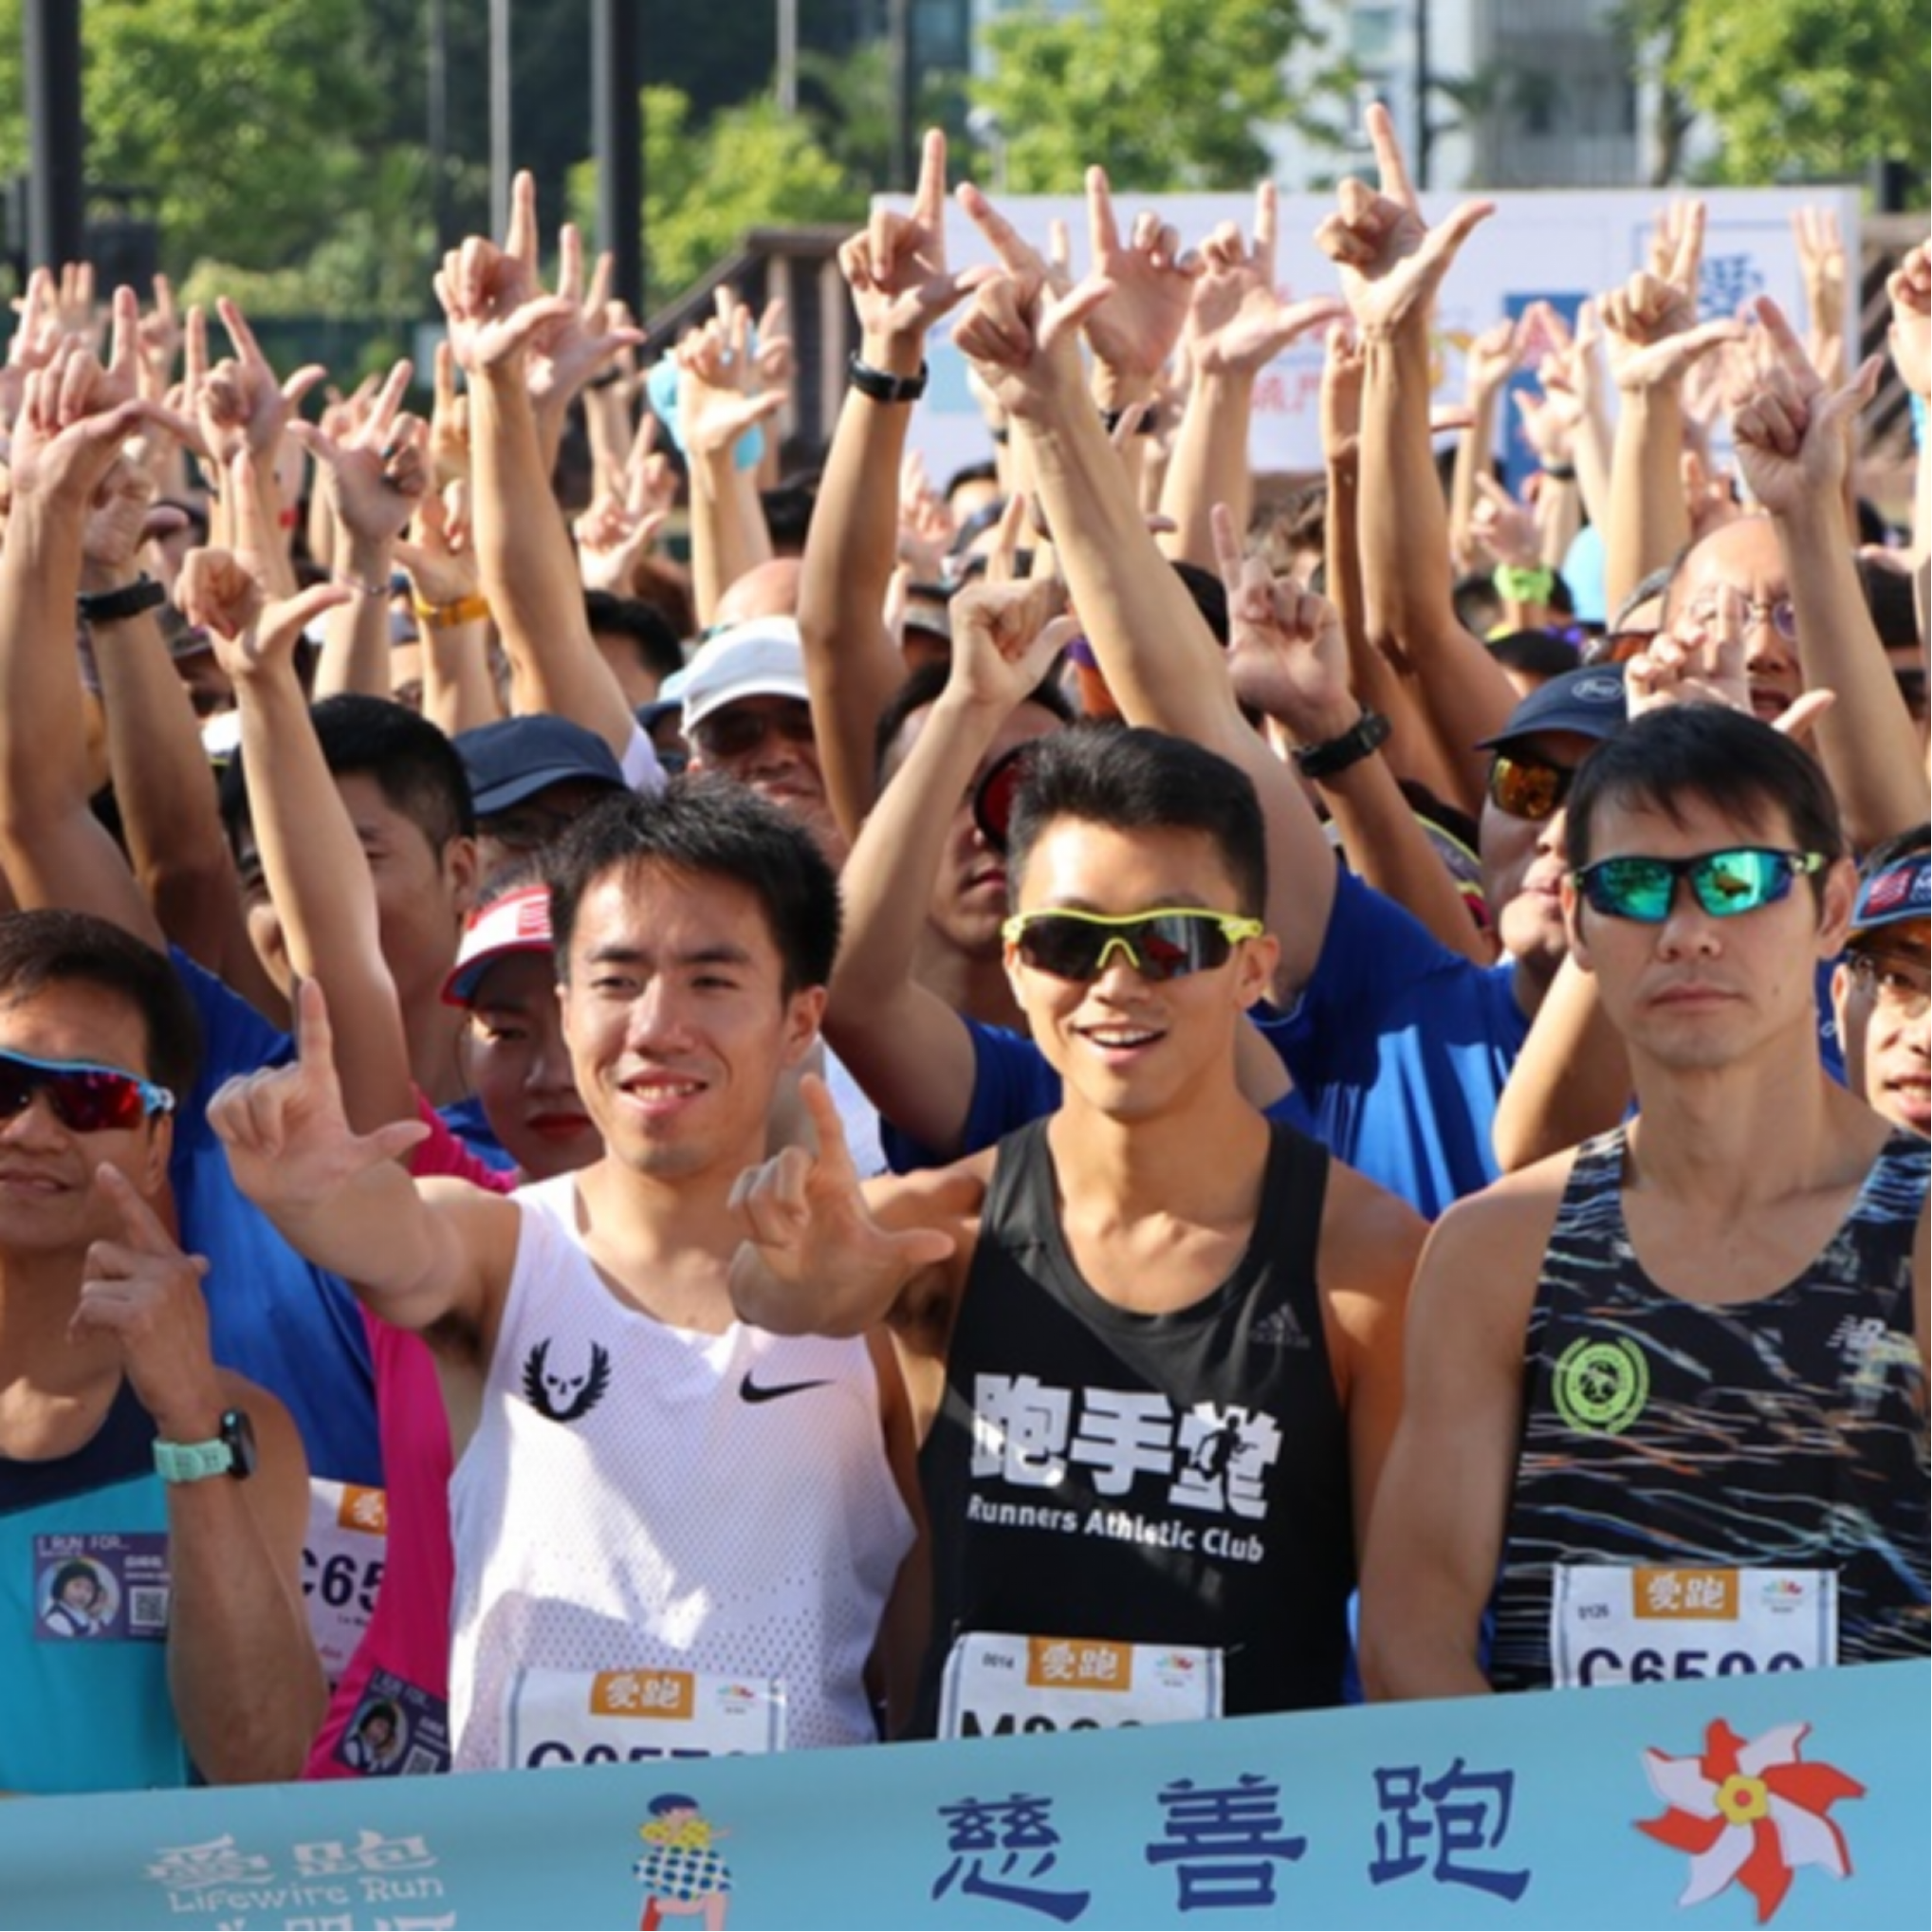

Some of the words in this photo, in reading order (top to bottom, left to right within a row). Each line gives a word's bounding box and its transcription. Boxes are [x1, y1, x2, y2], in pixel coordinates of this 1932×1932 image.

[970, 1372, 1284, 1518] 跑手堂
[967, 1495, 1078, 1533] Runners
[1084, 1509, 1195, 1552] Athletic
[1201, 1528, 1265, 1563] Club
[1647, 1573, 1724, 1610] 愛跑
[1040, 1643, 1118, 1680] 愛跑
[931, 1757, 1532, 1923] 慈善跑
[168, 1882, 350, 1914] Lifewire
[359, 1875, 445, 1904] Run
